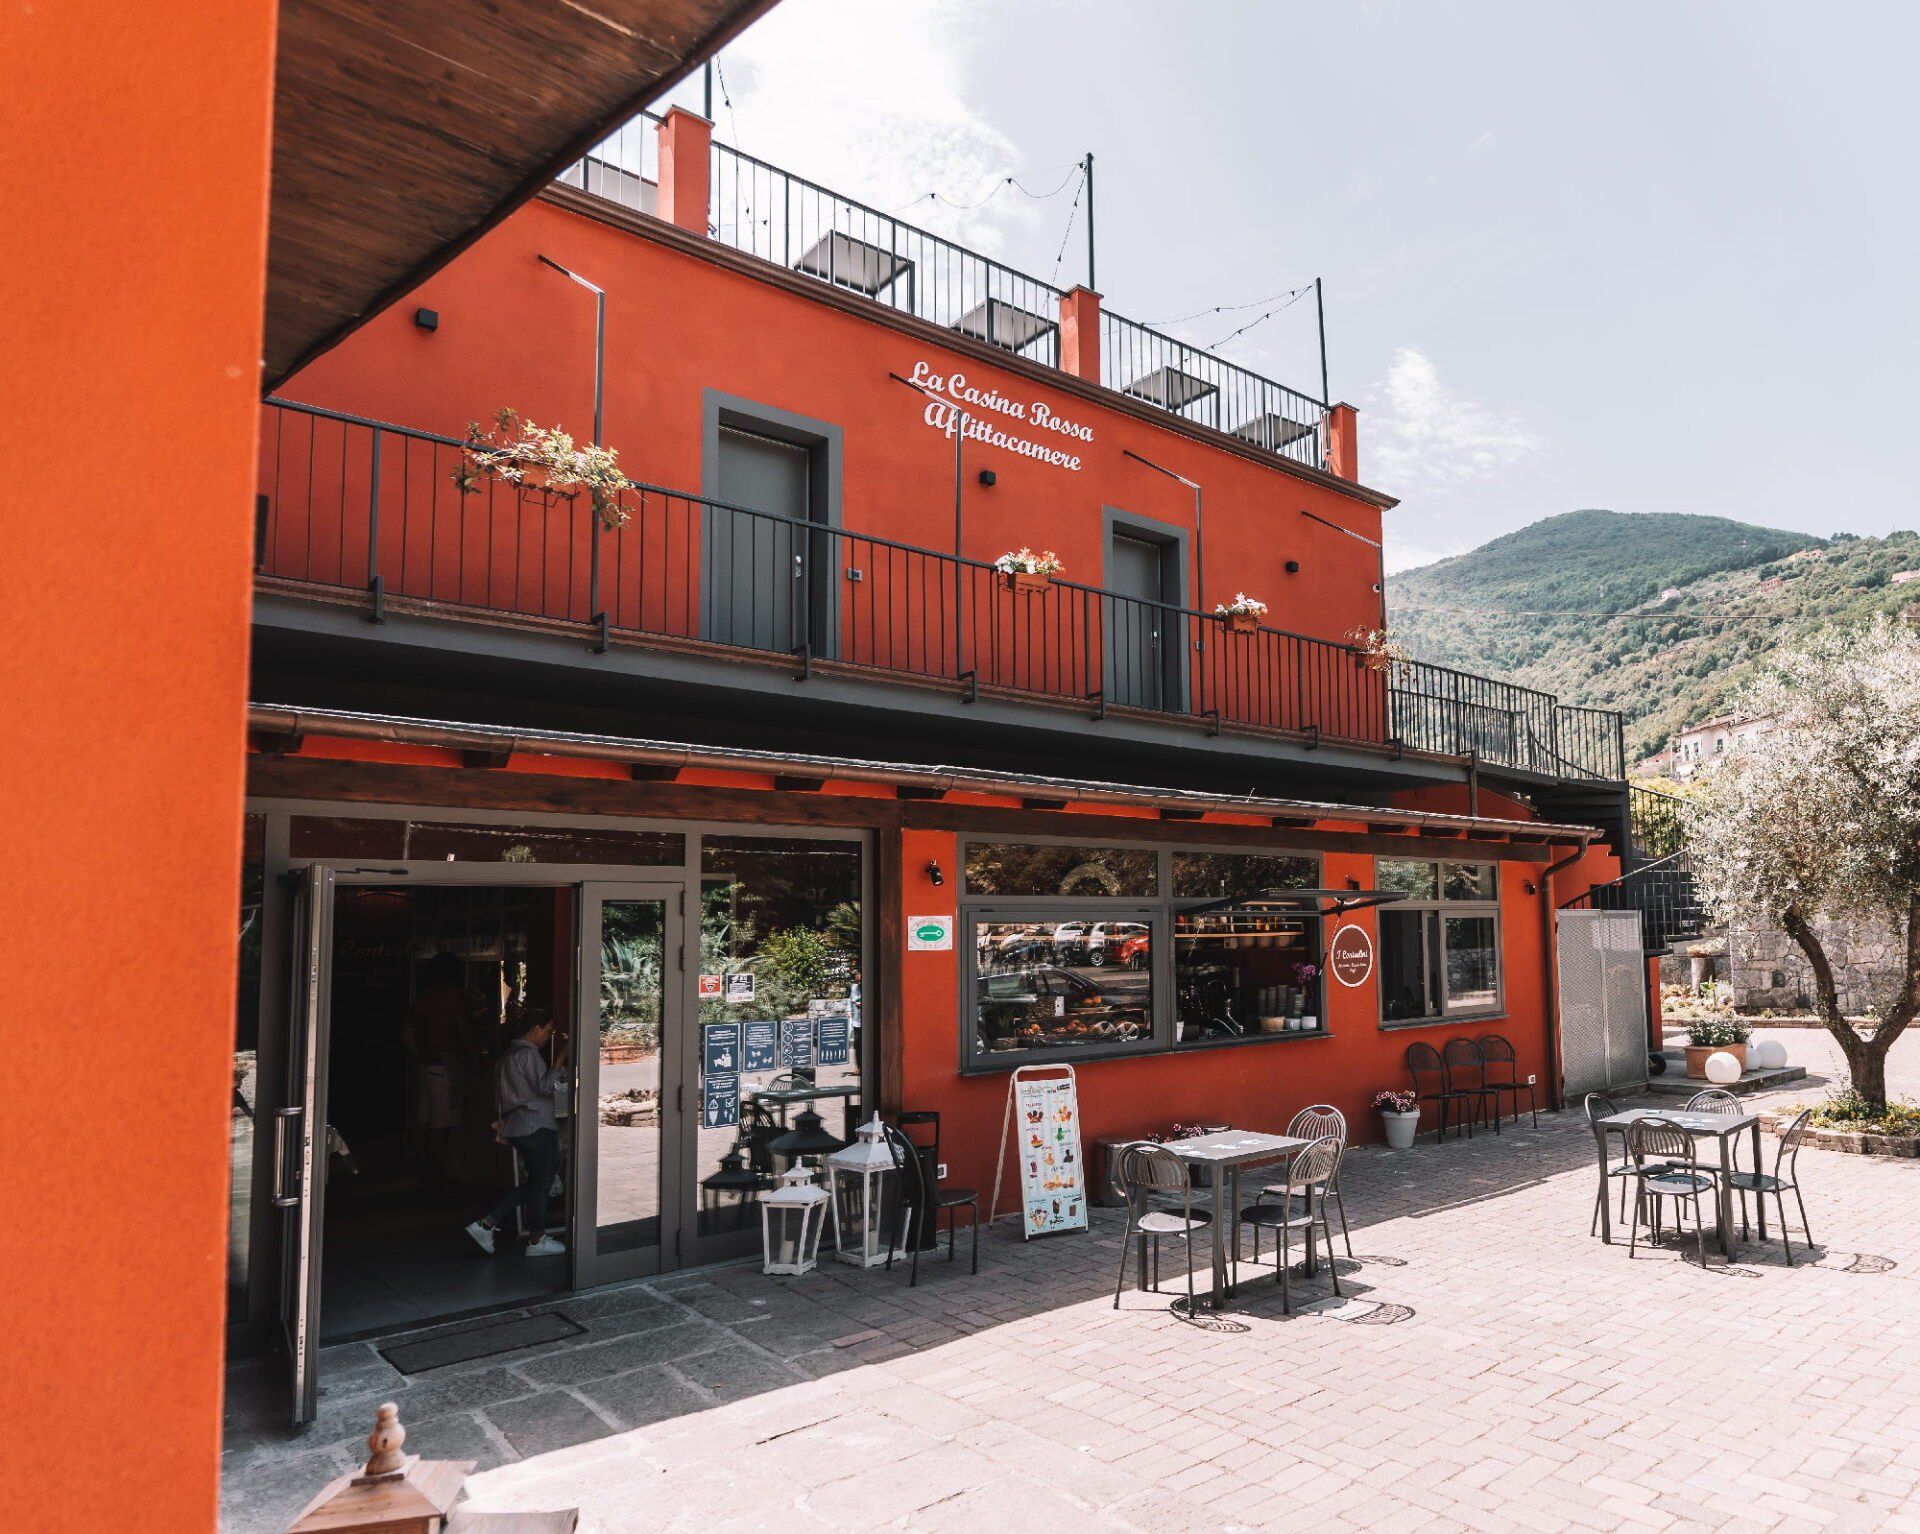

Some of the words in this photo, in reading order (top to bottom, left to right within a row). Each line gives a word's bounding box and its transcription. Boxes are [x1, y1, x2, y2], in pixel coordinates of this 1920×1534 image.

[907, 361, 945, 392] La
[948, 373, 1026, 419] Casina
[1029, 402, 1095, 443] Rossa
[924, 402, 1082, 471] Affittacamere
